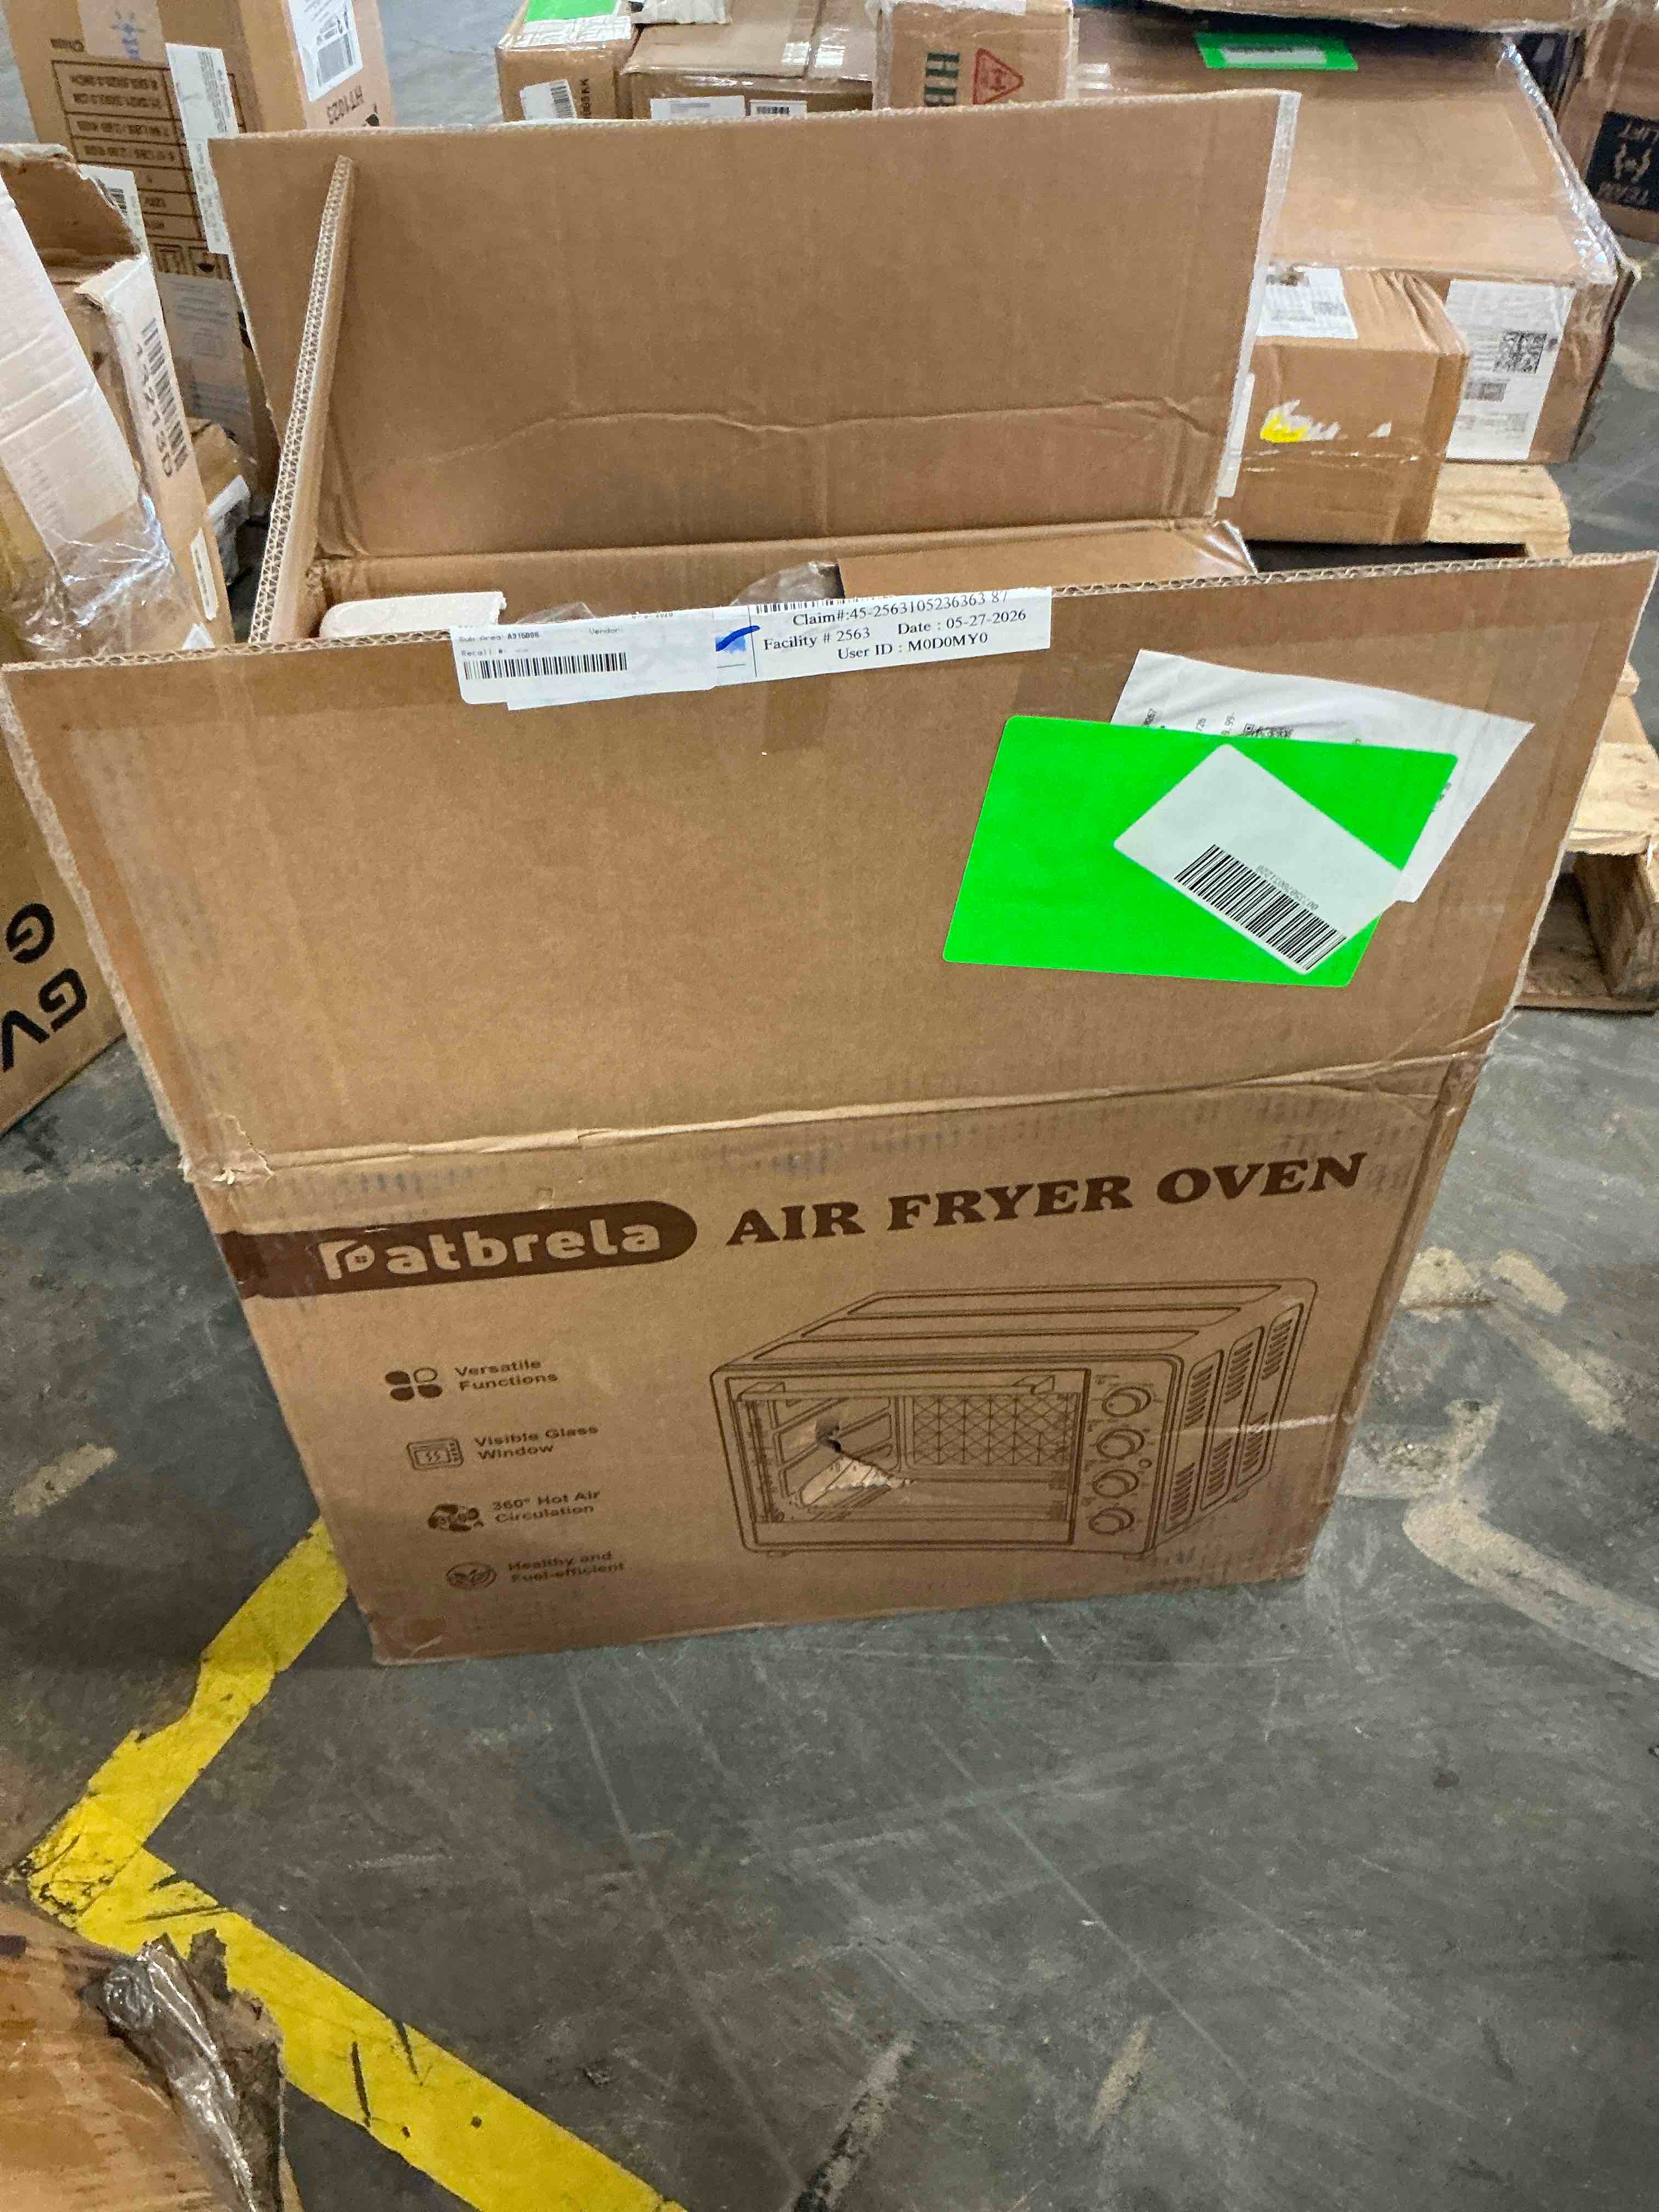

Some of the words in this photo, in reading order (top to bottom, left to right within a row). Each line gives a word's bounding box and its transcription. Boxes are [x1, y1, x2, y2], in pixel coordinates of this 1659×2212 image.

[763, 634, 817, 650] Facility
[822, 631, 830, 643] #
[837, 627, 870, 642] 2563
[898, 623, 932, 635] Date
[946, 608, 1027, 629] 05-27-2026
[838, 647, 870, 660] User
[875, 643, 893, 656] ID
[725, 1201, 866, 1245] AIR
[886, 1175, 1133, 1231] FRYER
[1157, 1152, 1368, 1204] OVEN
[454, 1358, 541, 1376] Versatile
[459, 1373, 558, 1392] Functions
[473, 1432, 539, 1447] Visible
[545, 1426, 599, 1440] Glass
[477, 1444, 554, 1460] Window
[537, 1493, 568, 1505] Hot
[574, 1490, 601, 1502] Air
[494, 1504, 594, 1523] Circulation
[508, 1558, 574, 1571] Healthy
[579, 1550, 612, 1563] and
